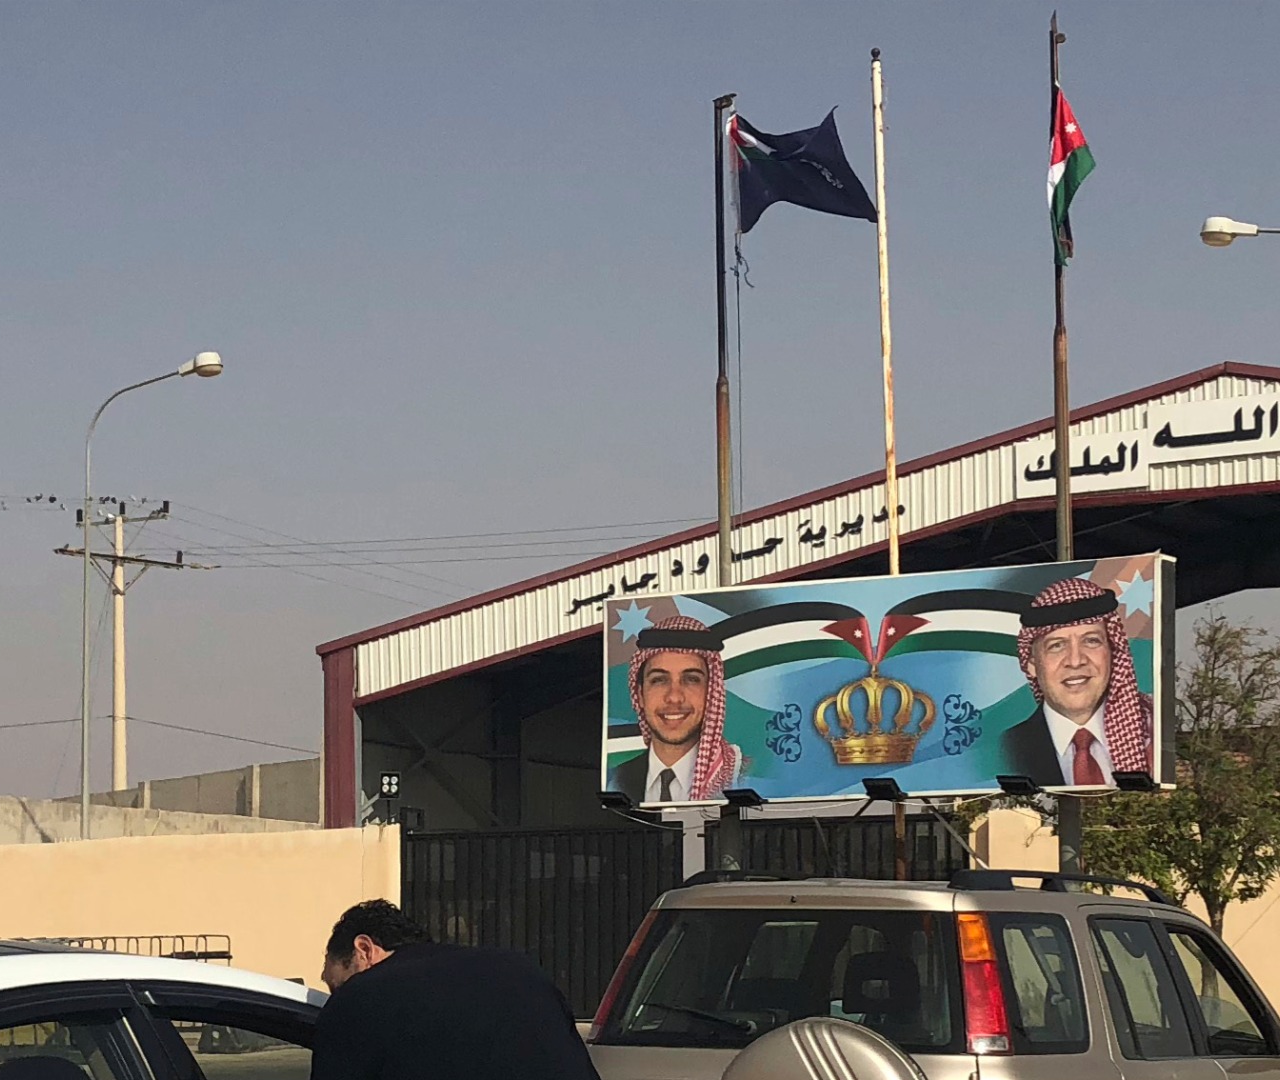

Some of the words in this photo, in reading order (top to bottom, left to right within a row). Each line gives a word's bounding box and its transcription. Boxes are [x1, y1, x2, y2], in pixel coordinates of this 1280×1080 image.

[1152, 401, 1280, 448] الله
[1023, 439, 1139, 482] الملك
[796, 504, 906, 549] مديرية
[670, 537, 784, 577] حود
[563, 572, 659, 617] جابر
